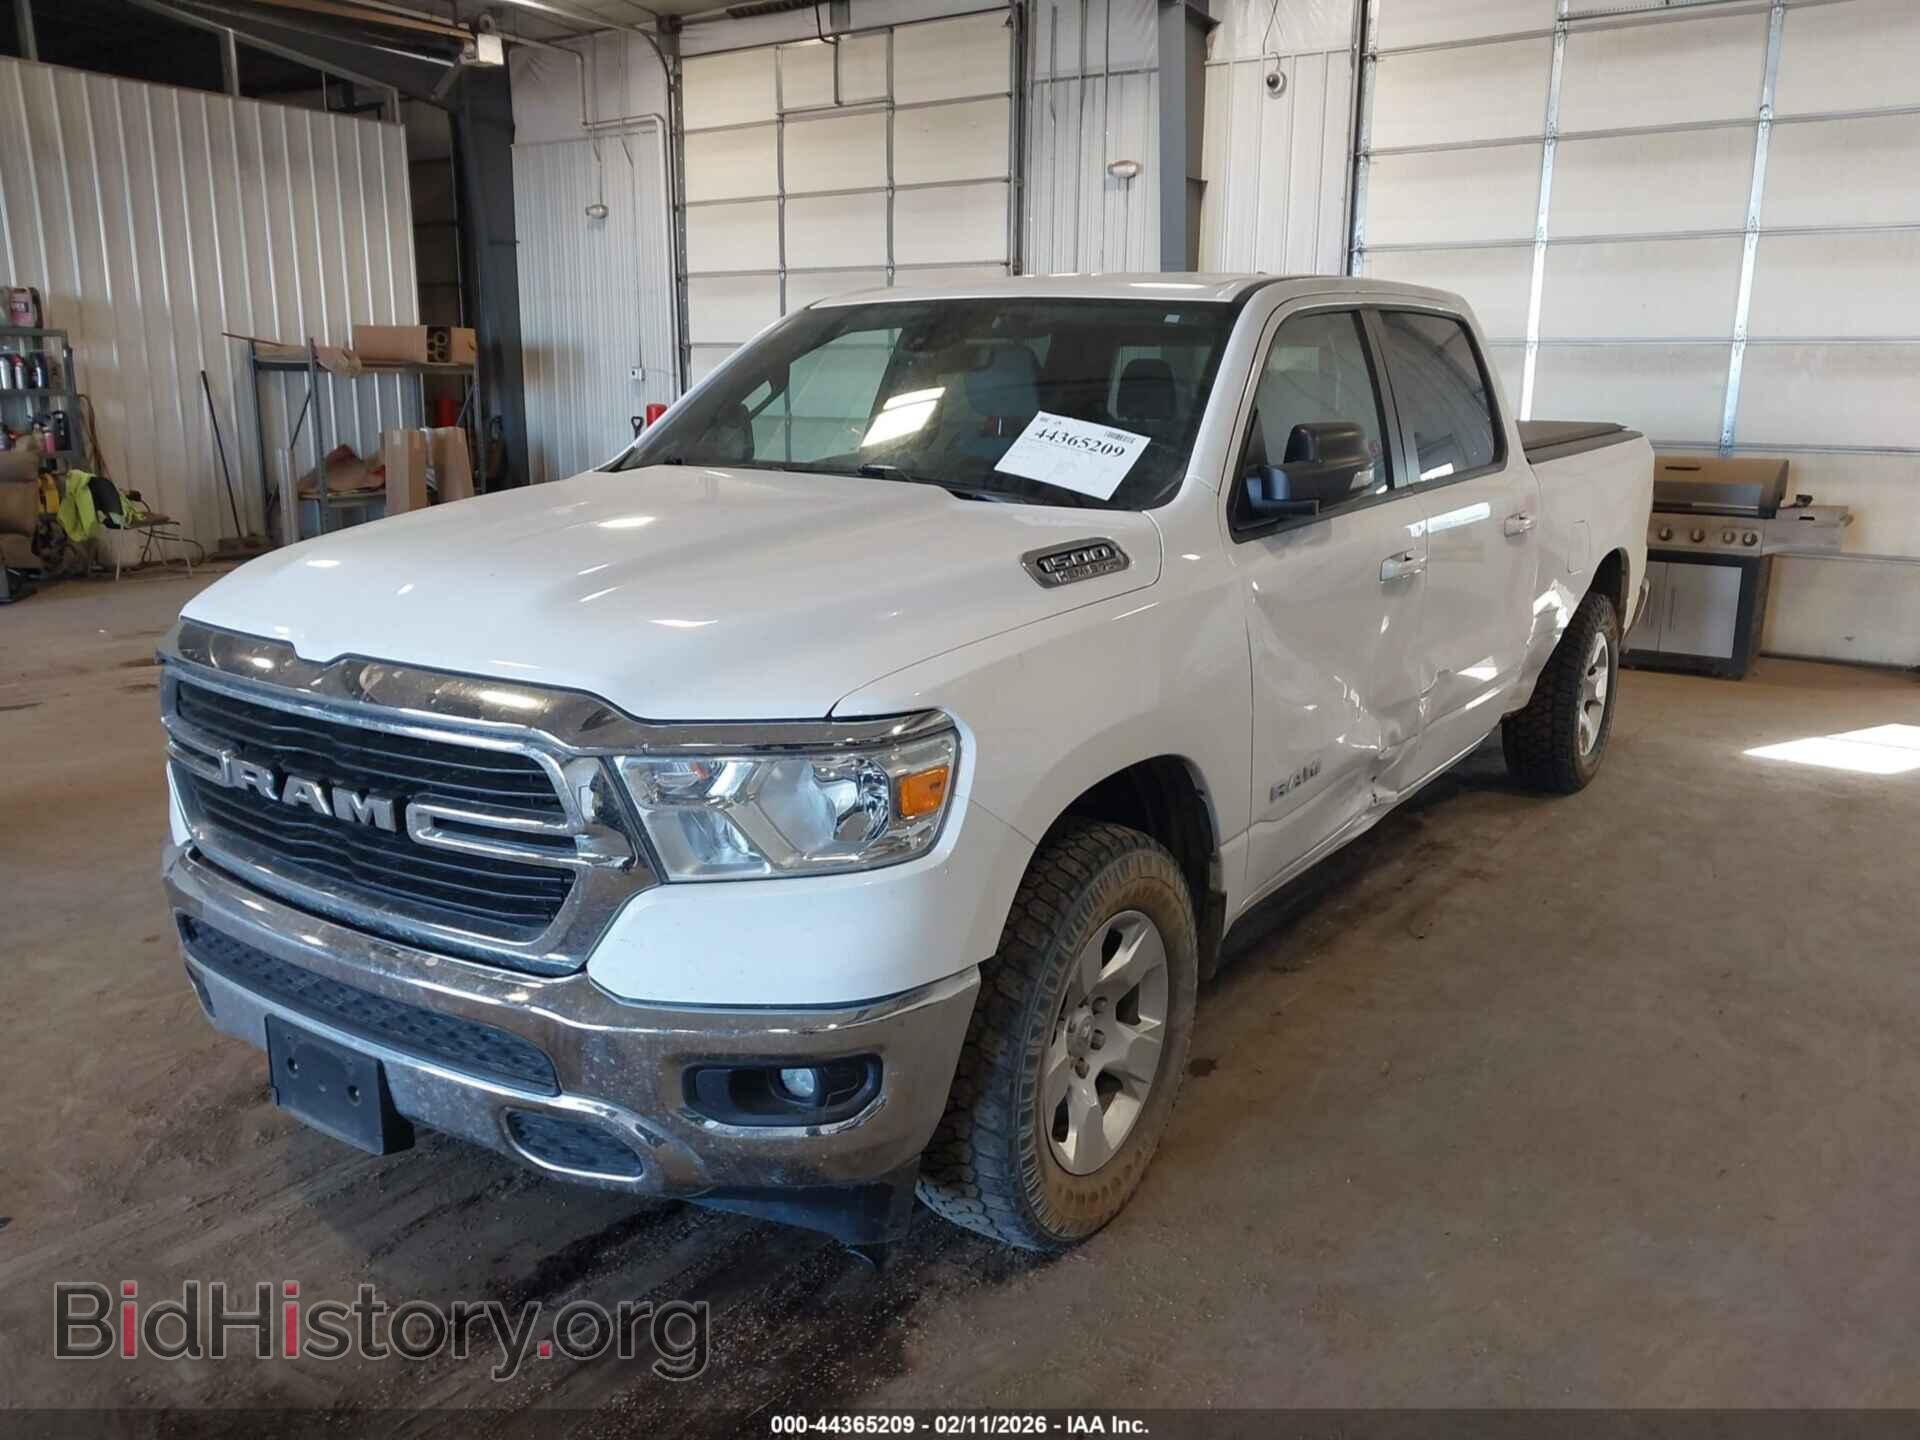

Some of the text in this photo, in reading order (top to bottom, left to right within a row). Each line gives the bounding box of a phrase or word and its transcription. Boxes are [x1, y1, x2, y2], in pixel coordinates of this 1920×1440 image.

[1034, 428, 1125, 457] 44365209
[1038, 546, 1113, 573] 1500
[228, 756, 398, 833] RAM
